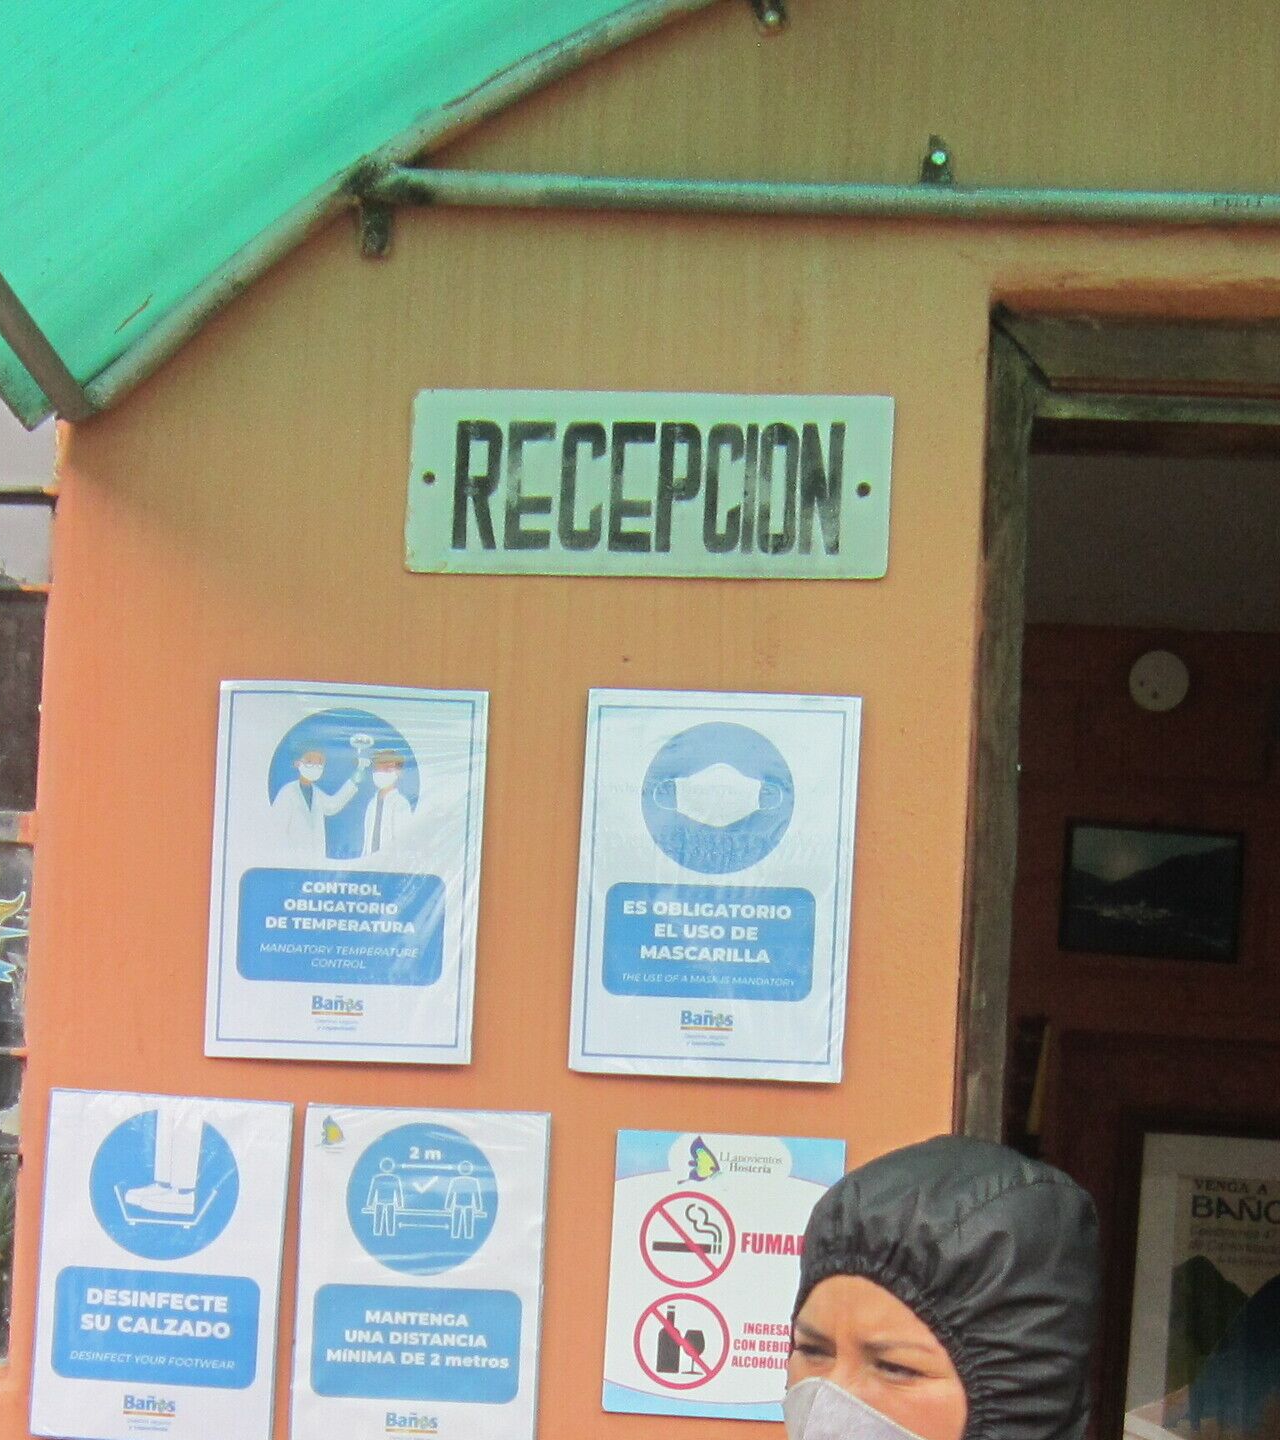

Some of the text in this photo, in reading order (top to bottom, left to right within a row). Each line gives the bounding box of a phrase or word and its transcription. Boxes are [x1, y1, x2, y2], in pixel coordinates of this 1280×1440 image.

[451, 420, 847, 555] RECEPCION
[302, 881, 382, 896] CONTROL
[284, 899, 399, 914] OBLIGATORIO
[623, 900, 792, 920] ES OBLIGATORIO
[265, 916, 415, 934] DE TEMPERATURA
[654, 923, 759, 941] EL USO DE
[260, 943, 419, 959] MANDATORY TEMPERATURE
[640, 945, 770, 964] MASCARILLA
[311, 958, 367, 970] CONTROL
[622, 973, 641, 982] THE
[644, 974, 662, 983] USE
[664, 974, 679, 984] OF
[681, 975, 688, 983] A
[732, 977, 795, 987] MANDATORY
[312, 994, 364, 1012] Baños
[681, 1009, 734, 1027] Baños
[409, 1146, 442, 1160] 2 m
[1193, 1178, 1268, 1195] VENGA A
[86, 1288, 228, 1313] DESINFECTE
[80, 1313, 231, 1339] SU CALZADO
[365, 1310, 469, 1327] MANTENGA
[345, 1329, 488, 1348] UNA DISTANCIA
[733, 1339, 756, 1351] CON
[70, 1350, 236, 1370] DESINFECT YOUR FOOTWEAR
[326, 1348, 510, 1369] MÍNIMA DE 2 metros
[124, 1394, 176, 1412] Baños
[385, 1412, 439, 1429] Baños
